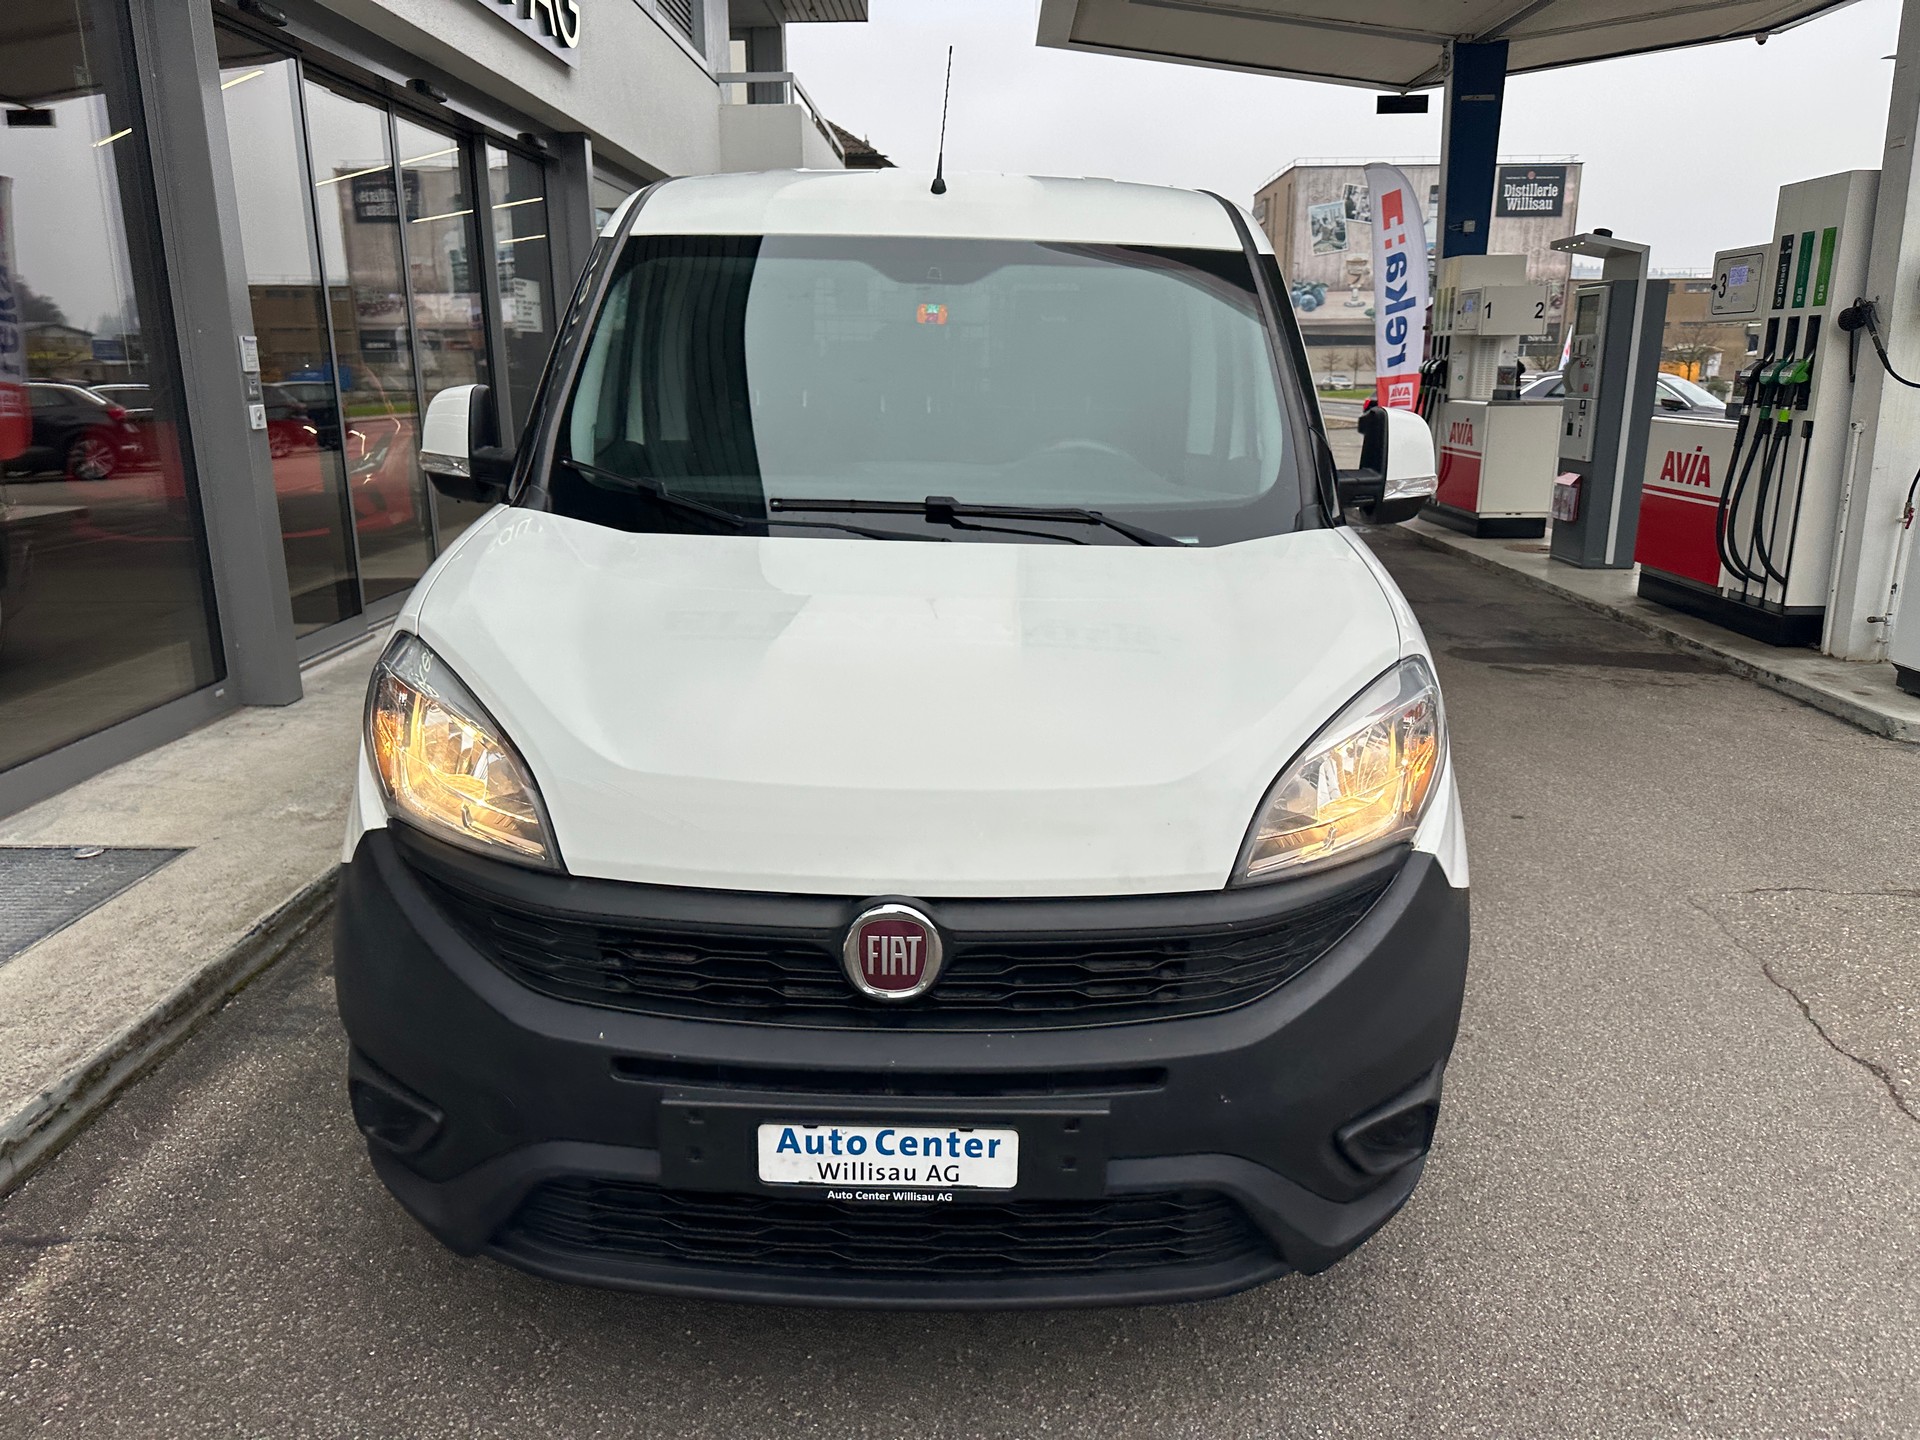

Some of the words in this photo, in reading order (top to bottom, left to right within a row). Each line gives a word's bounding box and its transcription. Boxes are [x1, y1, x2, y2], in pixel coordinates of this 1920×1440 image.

[1503, 183, 1559, 197] Distillerie
[1506, 197, 1553, 211] Willisau
[1718, 273, 1727, 298] 3
[1777, 263, 1787, 295] Diesel
[1484, 302, 1492, 319] 1
[1534, 302, 1544, 319] 2
[1449, 418, 1473, 446] AVIA
[1660, 446, 1710, 488] AVIA
[867, 935, 922, 976] FIAT
[776, 1127, 867, 1156] Auto
[875, 1129, 1001, 1159] Center
[817, 1162, 917, 1182] Willisau
[926, 1164, 961, 1183] AG
[827, 1190, 853, 1200] Auto
[855, 1191, 890, 1201] Center
[892, 1191, 935, 1202] Willisau
[936, 1192, 953, 1202] AG
